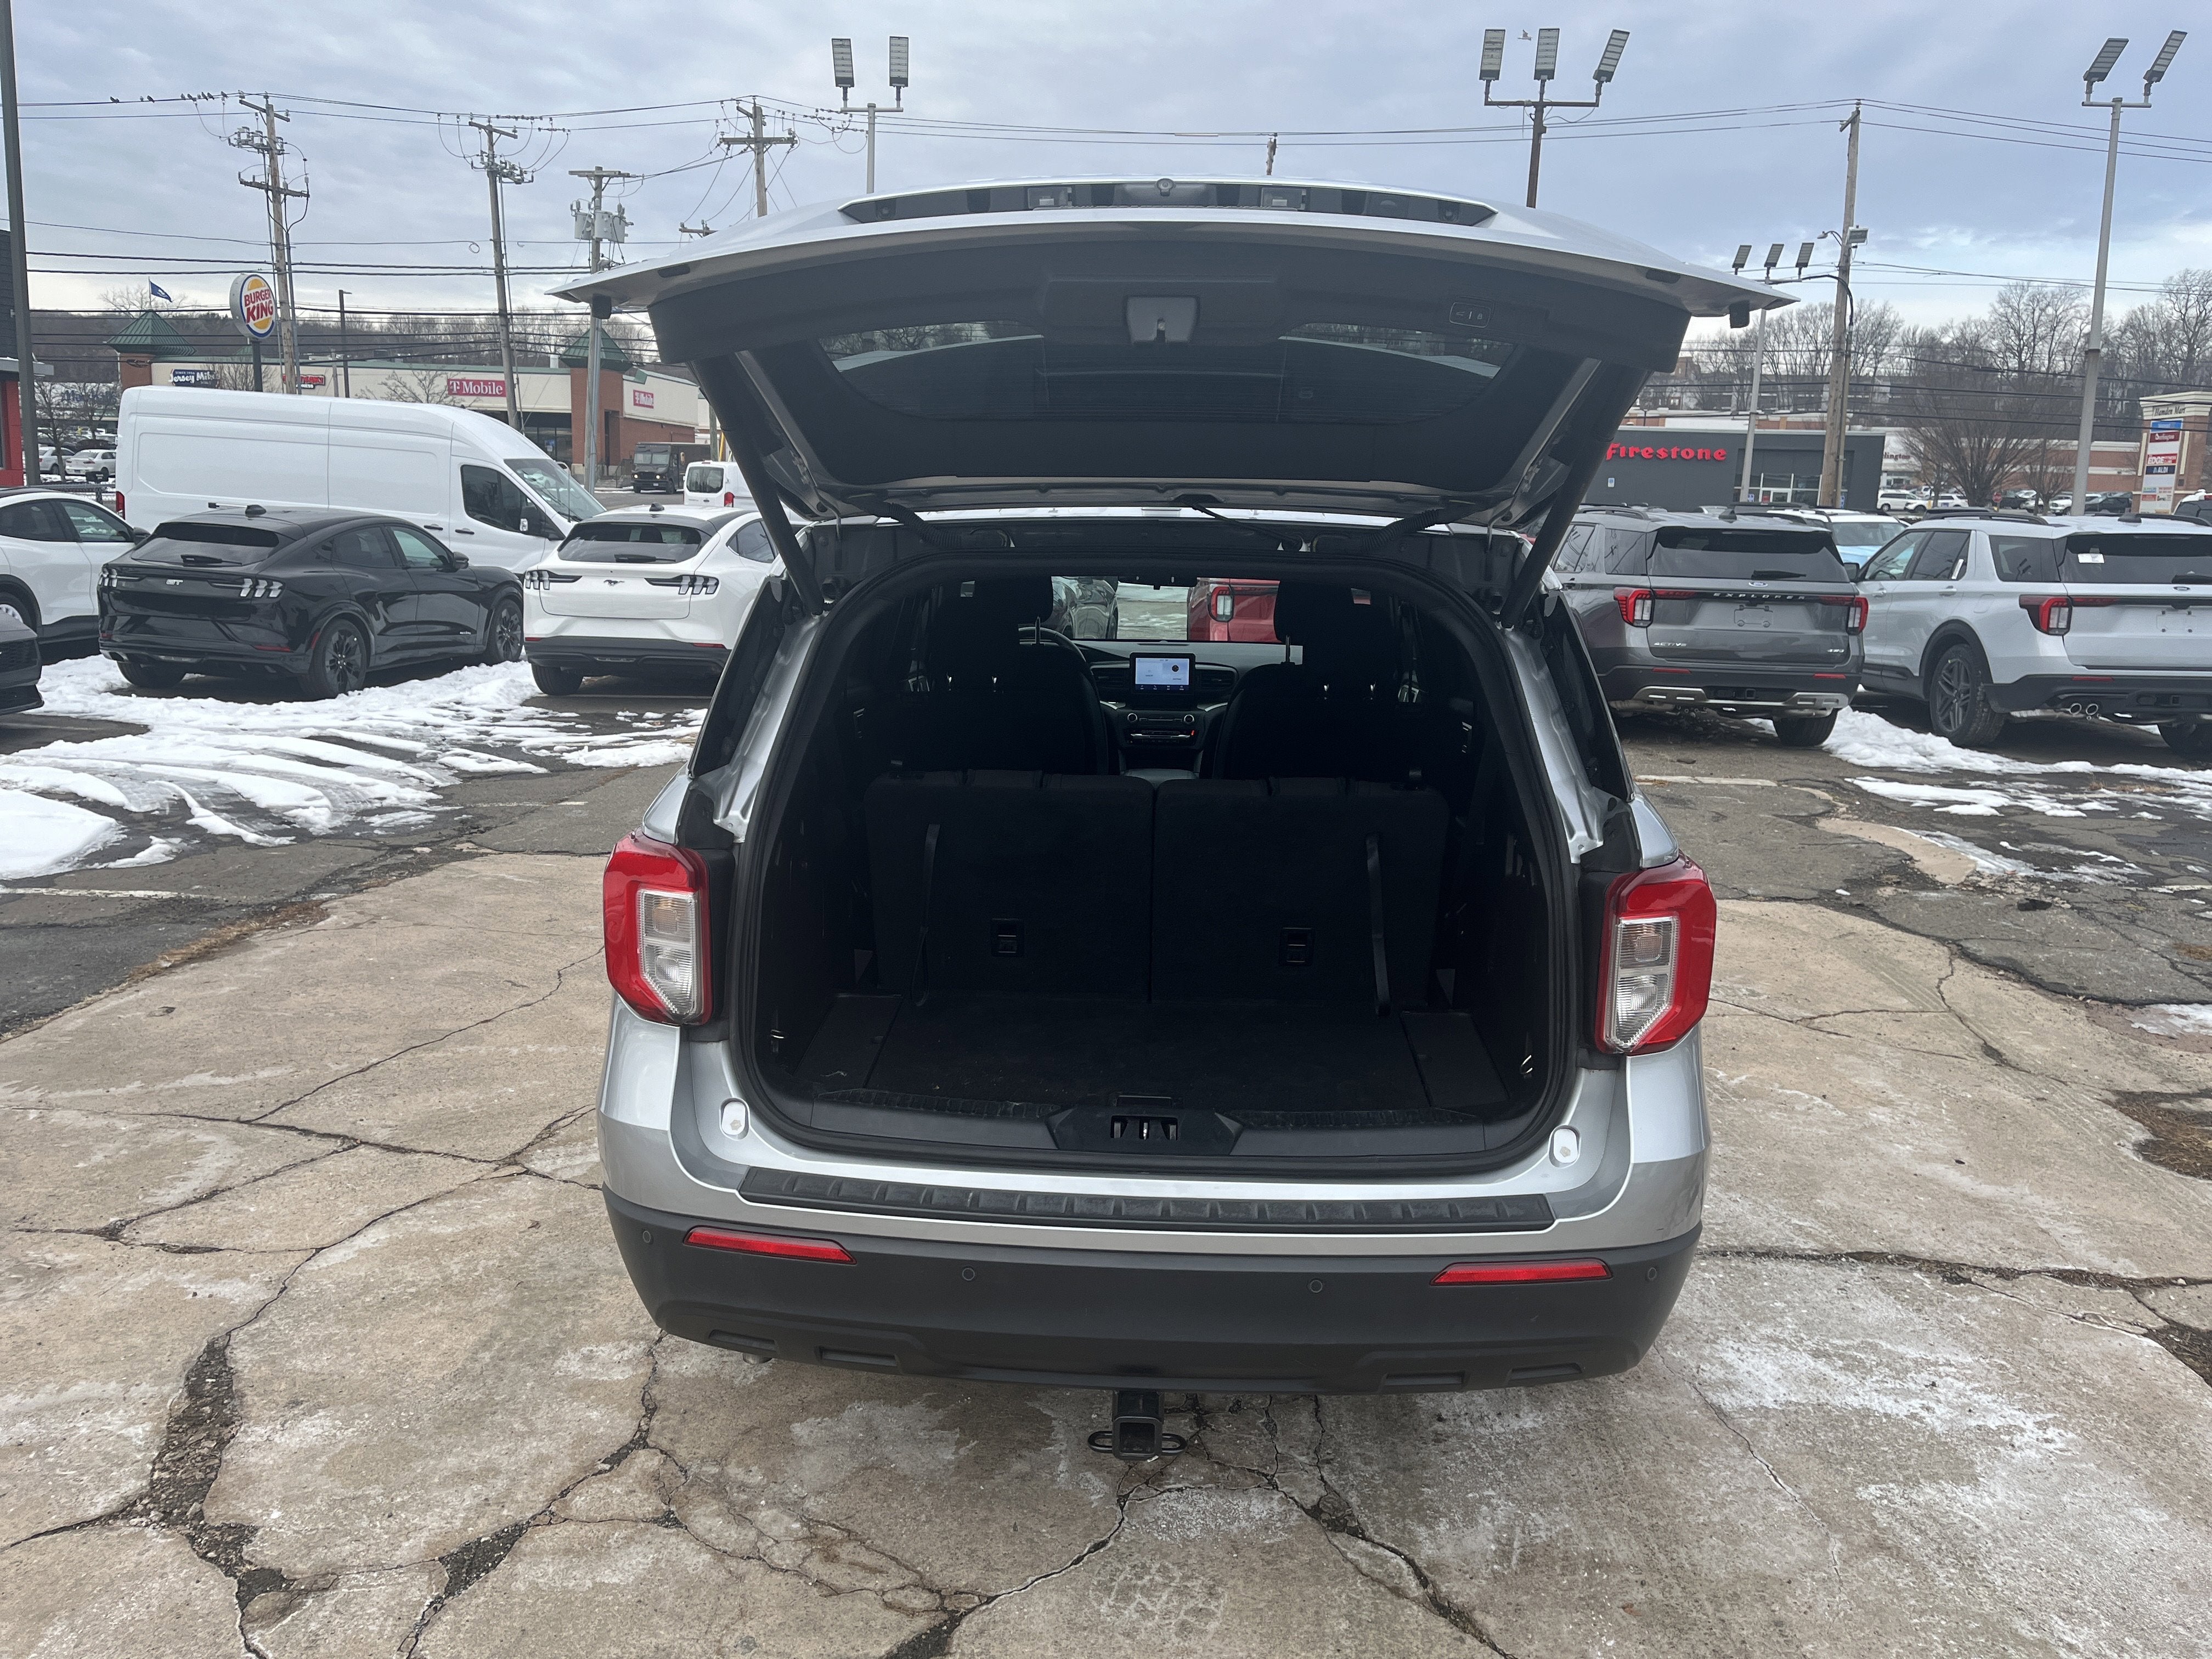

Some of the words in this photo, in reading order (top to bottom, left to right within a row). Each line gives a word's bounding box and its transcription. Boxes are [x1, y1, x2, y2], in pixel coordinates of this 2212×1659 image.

[244, 289, 271, 307] BURGER
[246, 300, 273, 324] KING
[168, 374, 194, 383] Jersey
[2155, 407, 2172, 416] Hamden
[1606, 443, 1727, 461] Firestone
[1883, 452, 1910, 461] lington
[2147, 456, 2164, 465] EDGE
